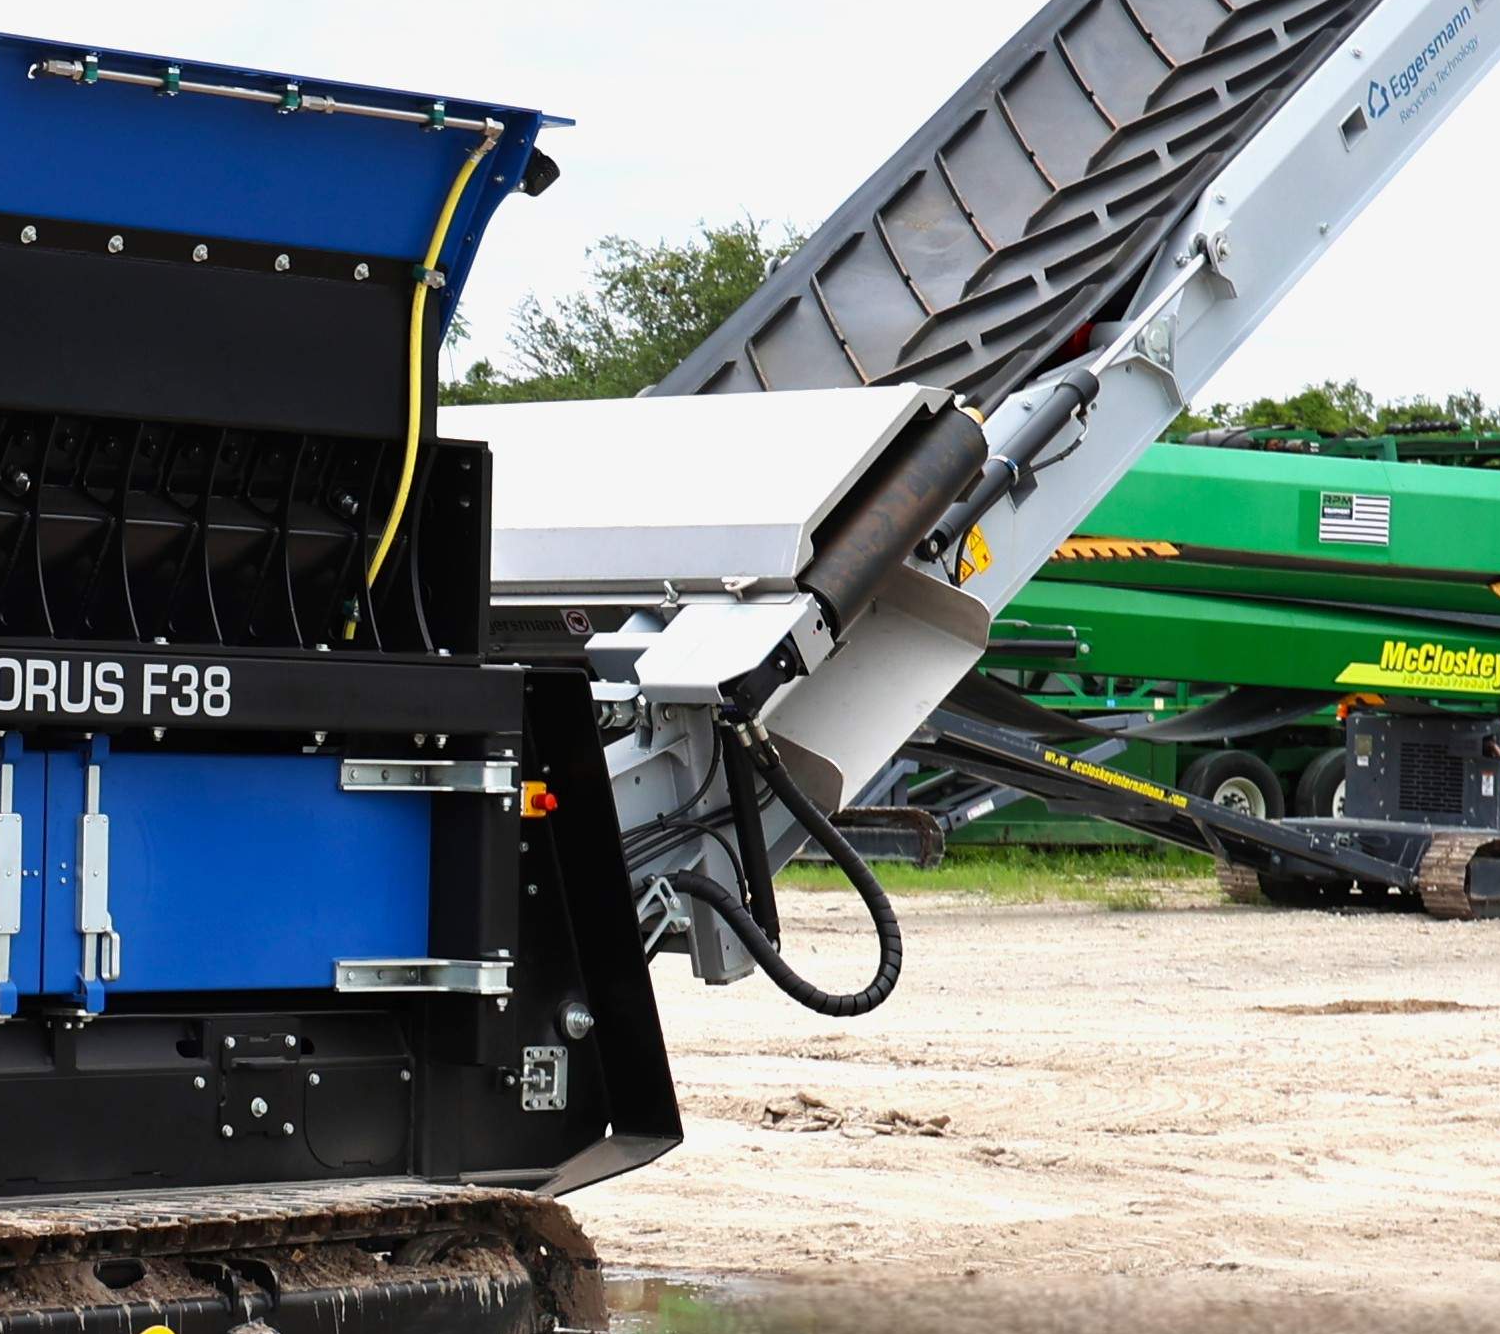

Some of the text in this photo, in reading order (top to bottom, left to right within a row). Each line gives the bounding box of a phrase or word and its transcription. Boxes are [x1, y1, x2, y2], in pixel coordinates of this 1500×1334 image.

[1389, 5, 1471, 99] Eggersmann
[1400, 34, 1480, 124] Recycling Technology
[142, 663, 231, 717] F38
